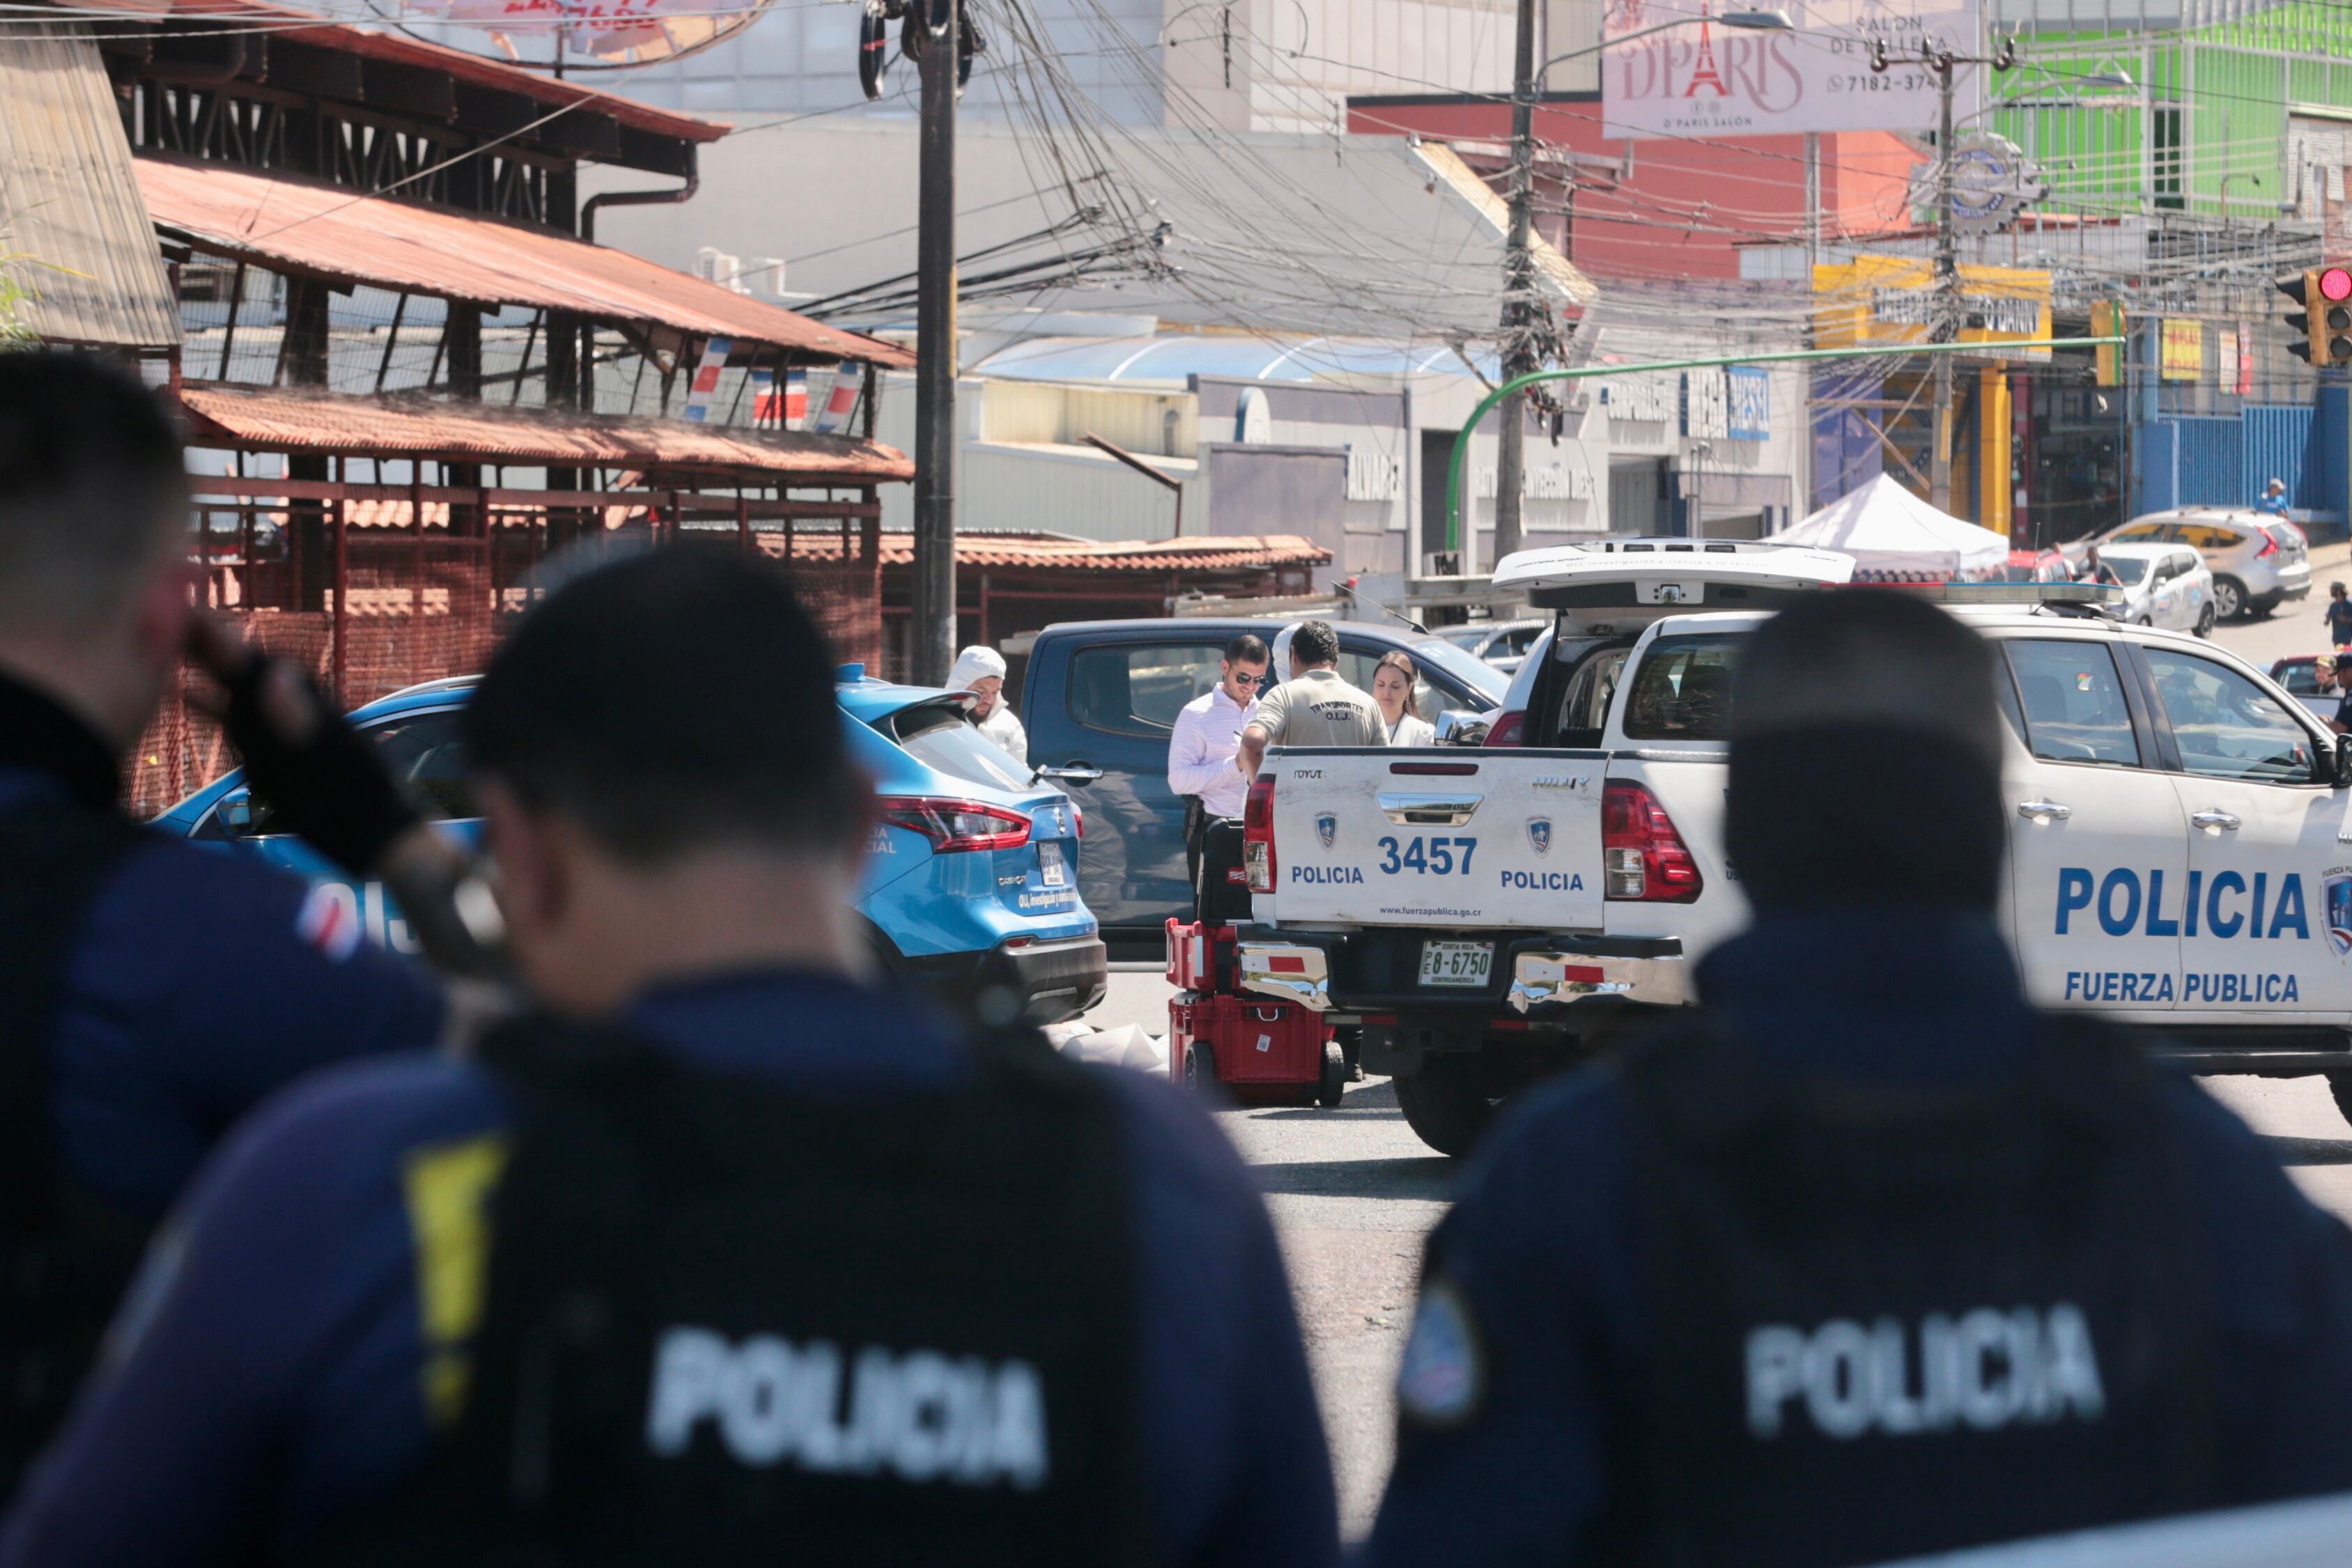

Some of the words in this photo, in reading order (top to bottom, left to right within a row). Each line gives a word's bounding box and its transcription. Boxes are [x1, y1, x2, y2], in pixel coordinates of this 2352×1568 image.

[1831, 38, 1855, 54] DE
[1310, 701, 1364, 713] TRANSPORTES
[1326, 712, 1351, 720] O.I.J.
[1377, 836, 1478, 875] 3457
[1291, 866, 1365, 884] POLICIA
[1501, 871, 1584, 891] POLICIA
[1379, 907, 1482, 917] www.fuerzapublica.go.cr
[2055, 867, 2310, 940] POLICIA
[1432, 952, 1489, 975] 8-6750
[2064, 972, 2174, 1002] FUERZA
[2183, 974, 2299, 1002] PUBLICA
[1745, 1303, 2104, 1441] POLICIA
[648, 1326, 1048, 1489] POLICIA
